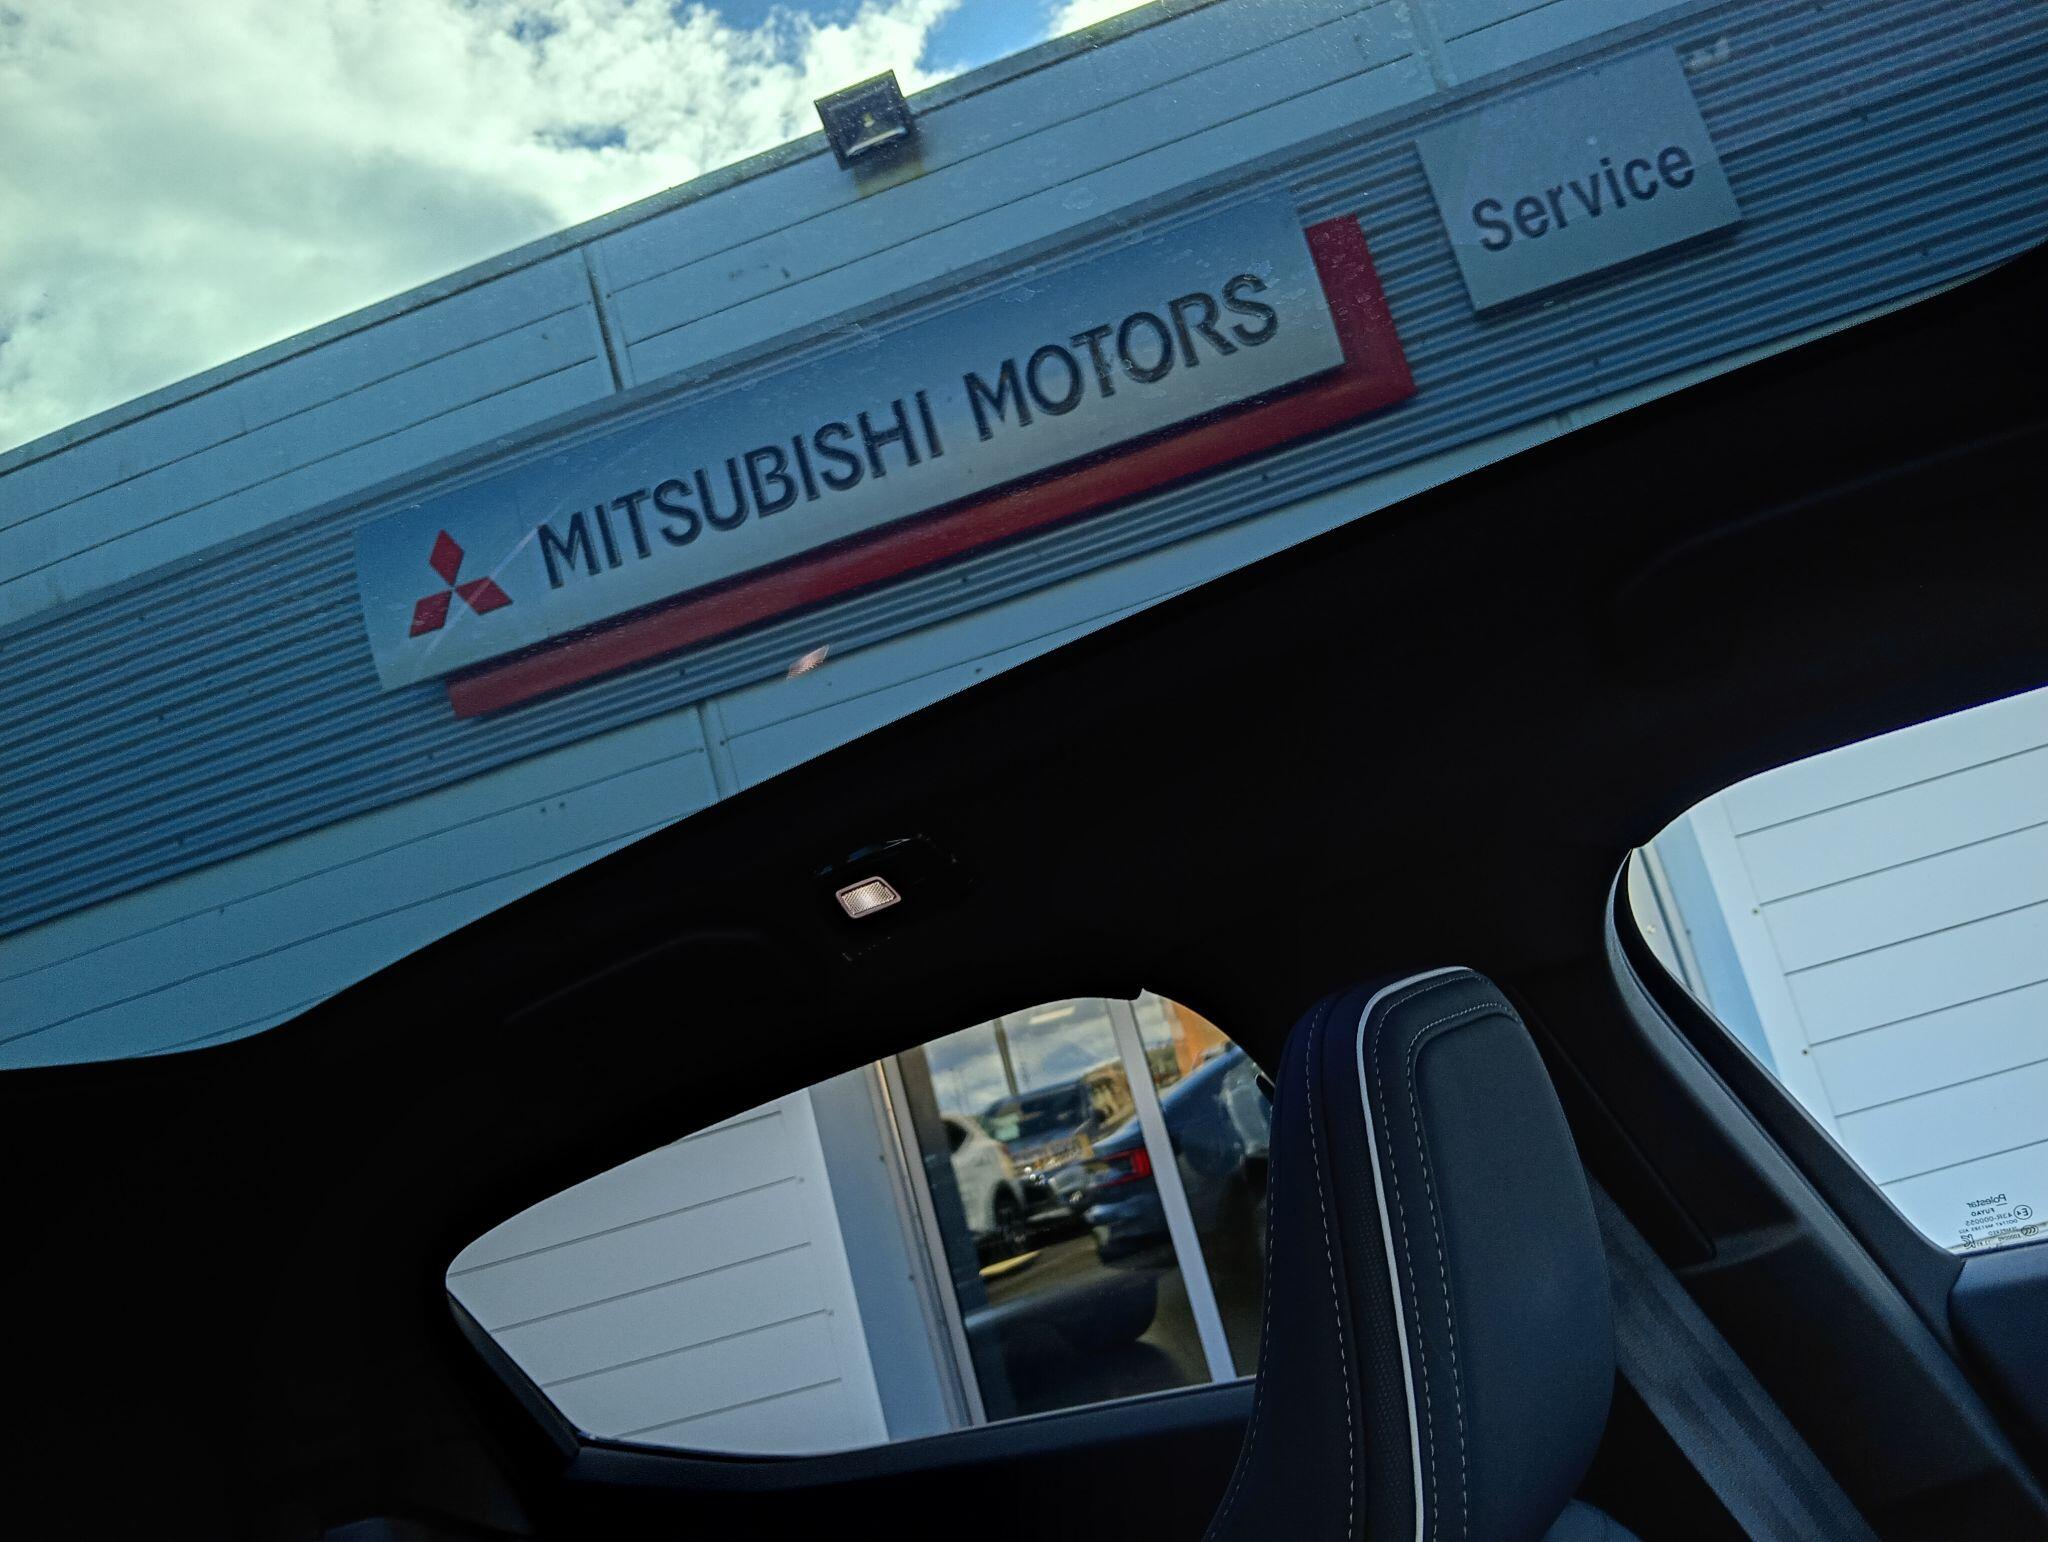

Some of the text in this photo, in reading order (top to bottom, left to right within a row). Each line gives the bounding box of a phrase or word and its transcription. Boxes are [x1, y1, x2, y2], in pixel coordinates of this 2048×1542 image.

[1472, 145, 1696, 252] Service
[536, 273, 1279, 590] MITSUBISHI MOTORS
